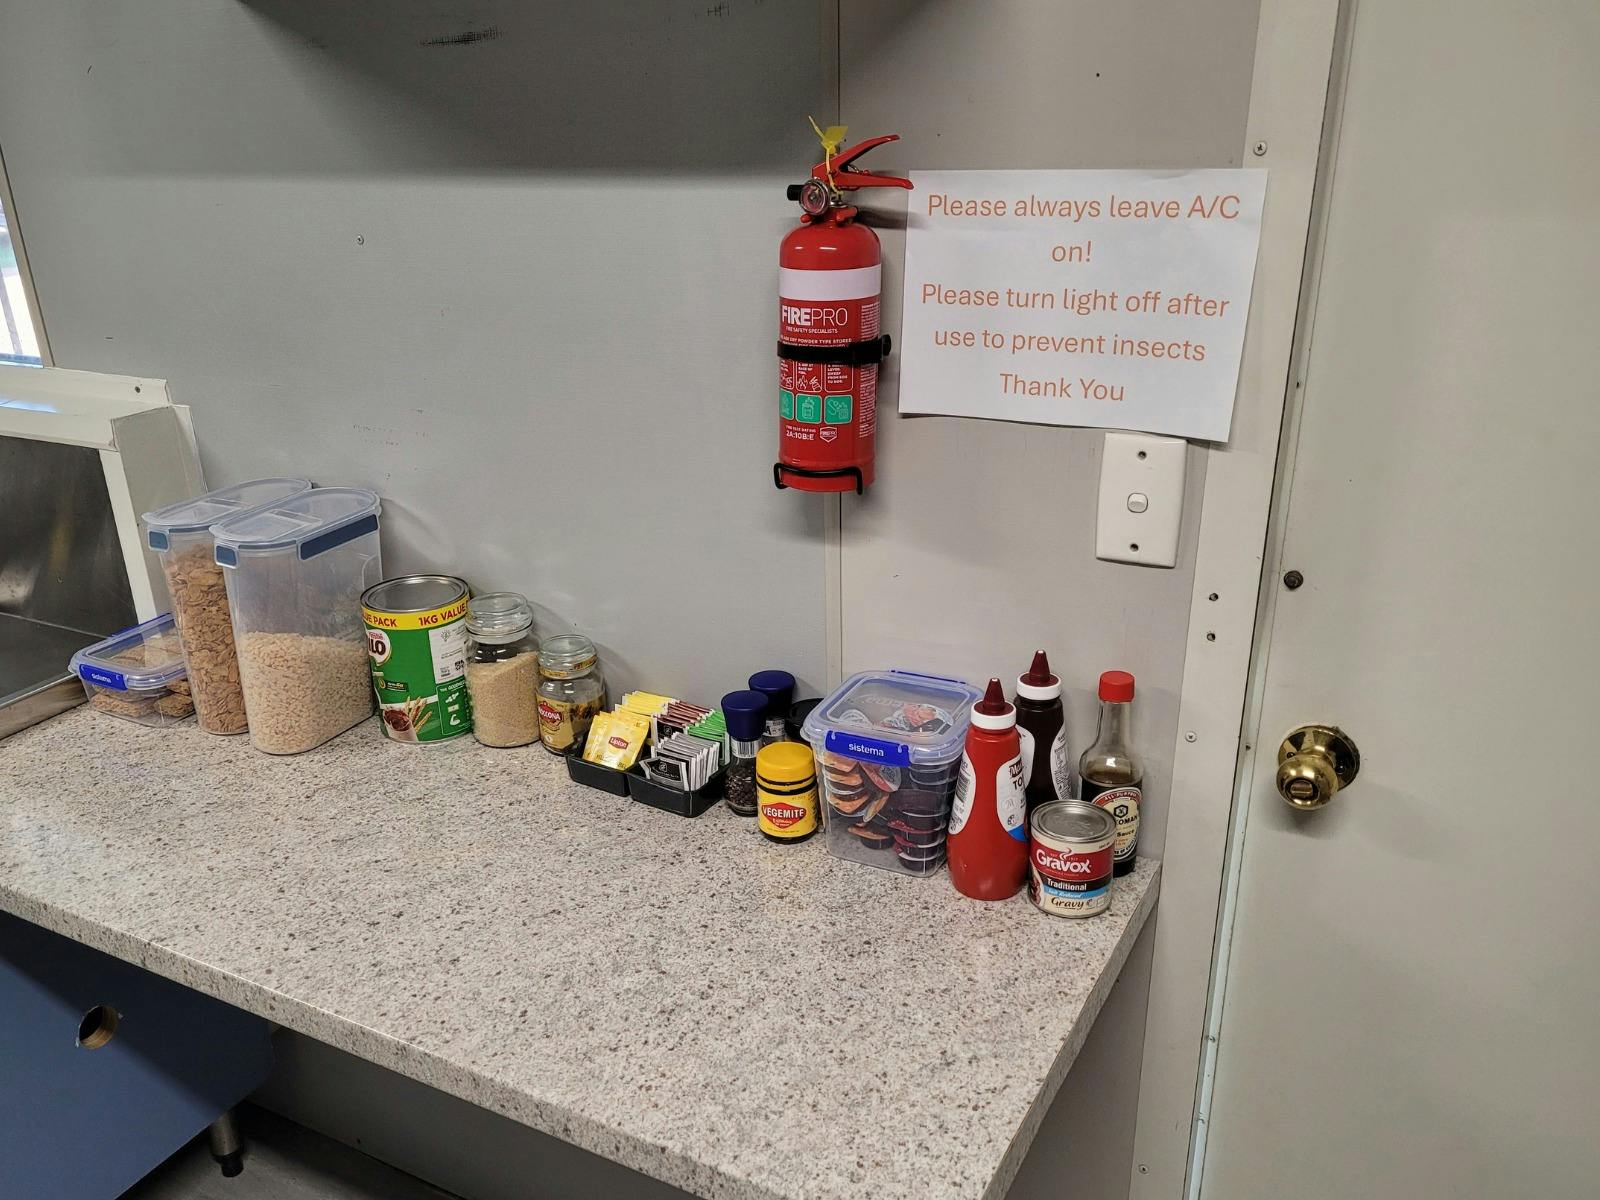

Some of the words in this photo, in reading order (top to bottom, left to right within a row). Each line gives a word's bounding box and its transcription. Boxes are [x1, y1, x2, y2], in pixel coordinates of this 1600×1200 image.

[928, 194, 1006, 217] Please
[1014, 194, 1101, 222] always
[1110, 196, 1180, 218] leave
[1188, 195, 1240, 219] A/C
[1052, 241, 1092, 262] on!
[922, 284, 999, 305] Please
[1006, 289, 1054, 309] turn
[1063, 289, 1117, 315] light
[1126, 292, 1161, 313] off
[1168, 293, 1229, 317] after
[782, 305, 847, 326] FIREPRO
[935, 329, 975, 347] use
[982, 330, 1004, 349] to
[1012, 334, 1105, 354] prevent
[1113, 334, 1205, 361] insects
[1000, 374, 1072, 398] Thank
[1080, 379, 1124, 401] You
[373, 616, 397, 627] PACK
[419, 616, 438, 626] 1KG
[440, 602, 466, 620] VALUE
[368, 638, 386, 655] ILO
[610, 738, 628, 748] Lipton
[848, 743, 884, 756] sistema
[763, 806, 804, 818] VEGEMITE
[1116, 816, 1137, 825] OMAN
[1117, 829, 1134, 837] Sauce
[1036, 849, 1091, 873] Gravox
[1047, 878, 1087, 890] Traditional
[1052, 897, 1084, 909] Gravy
